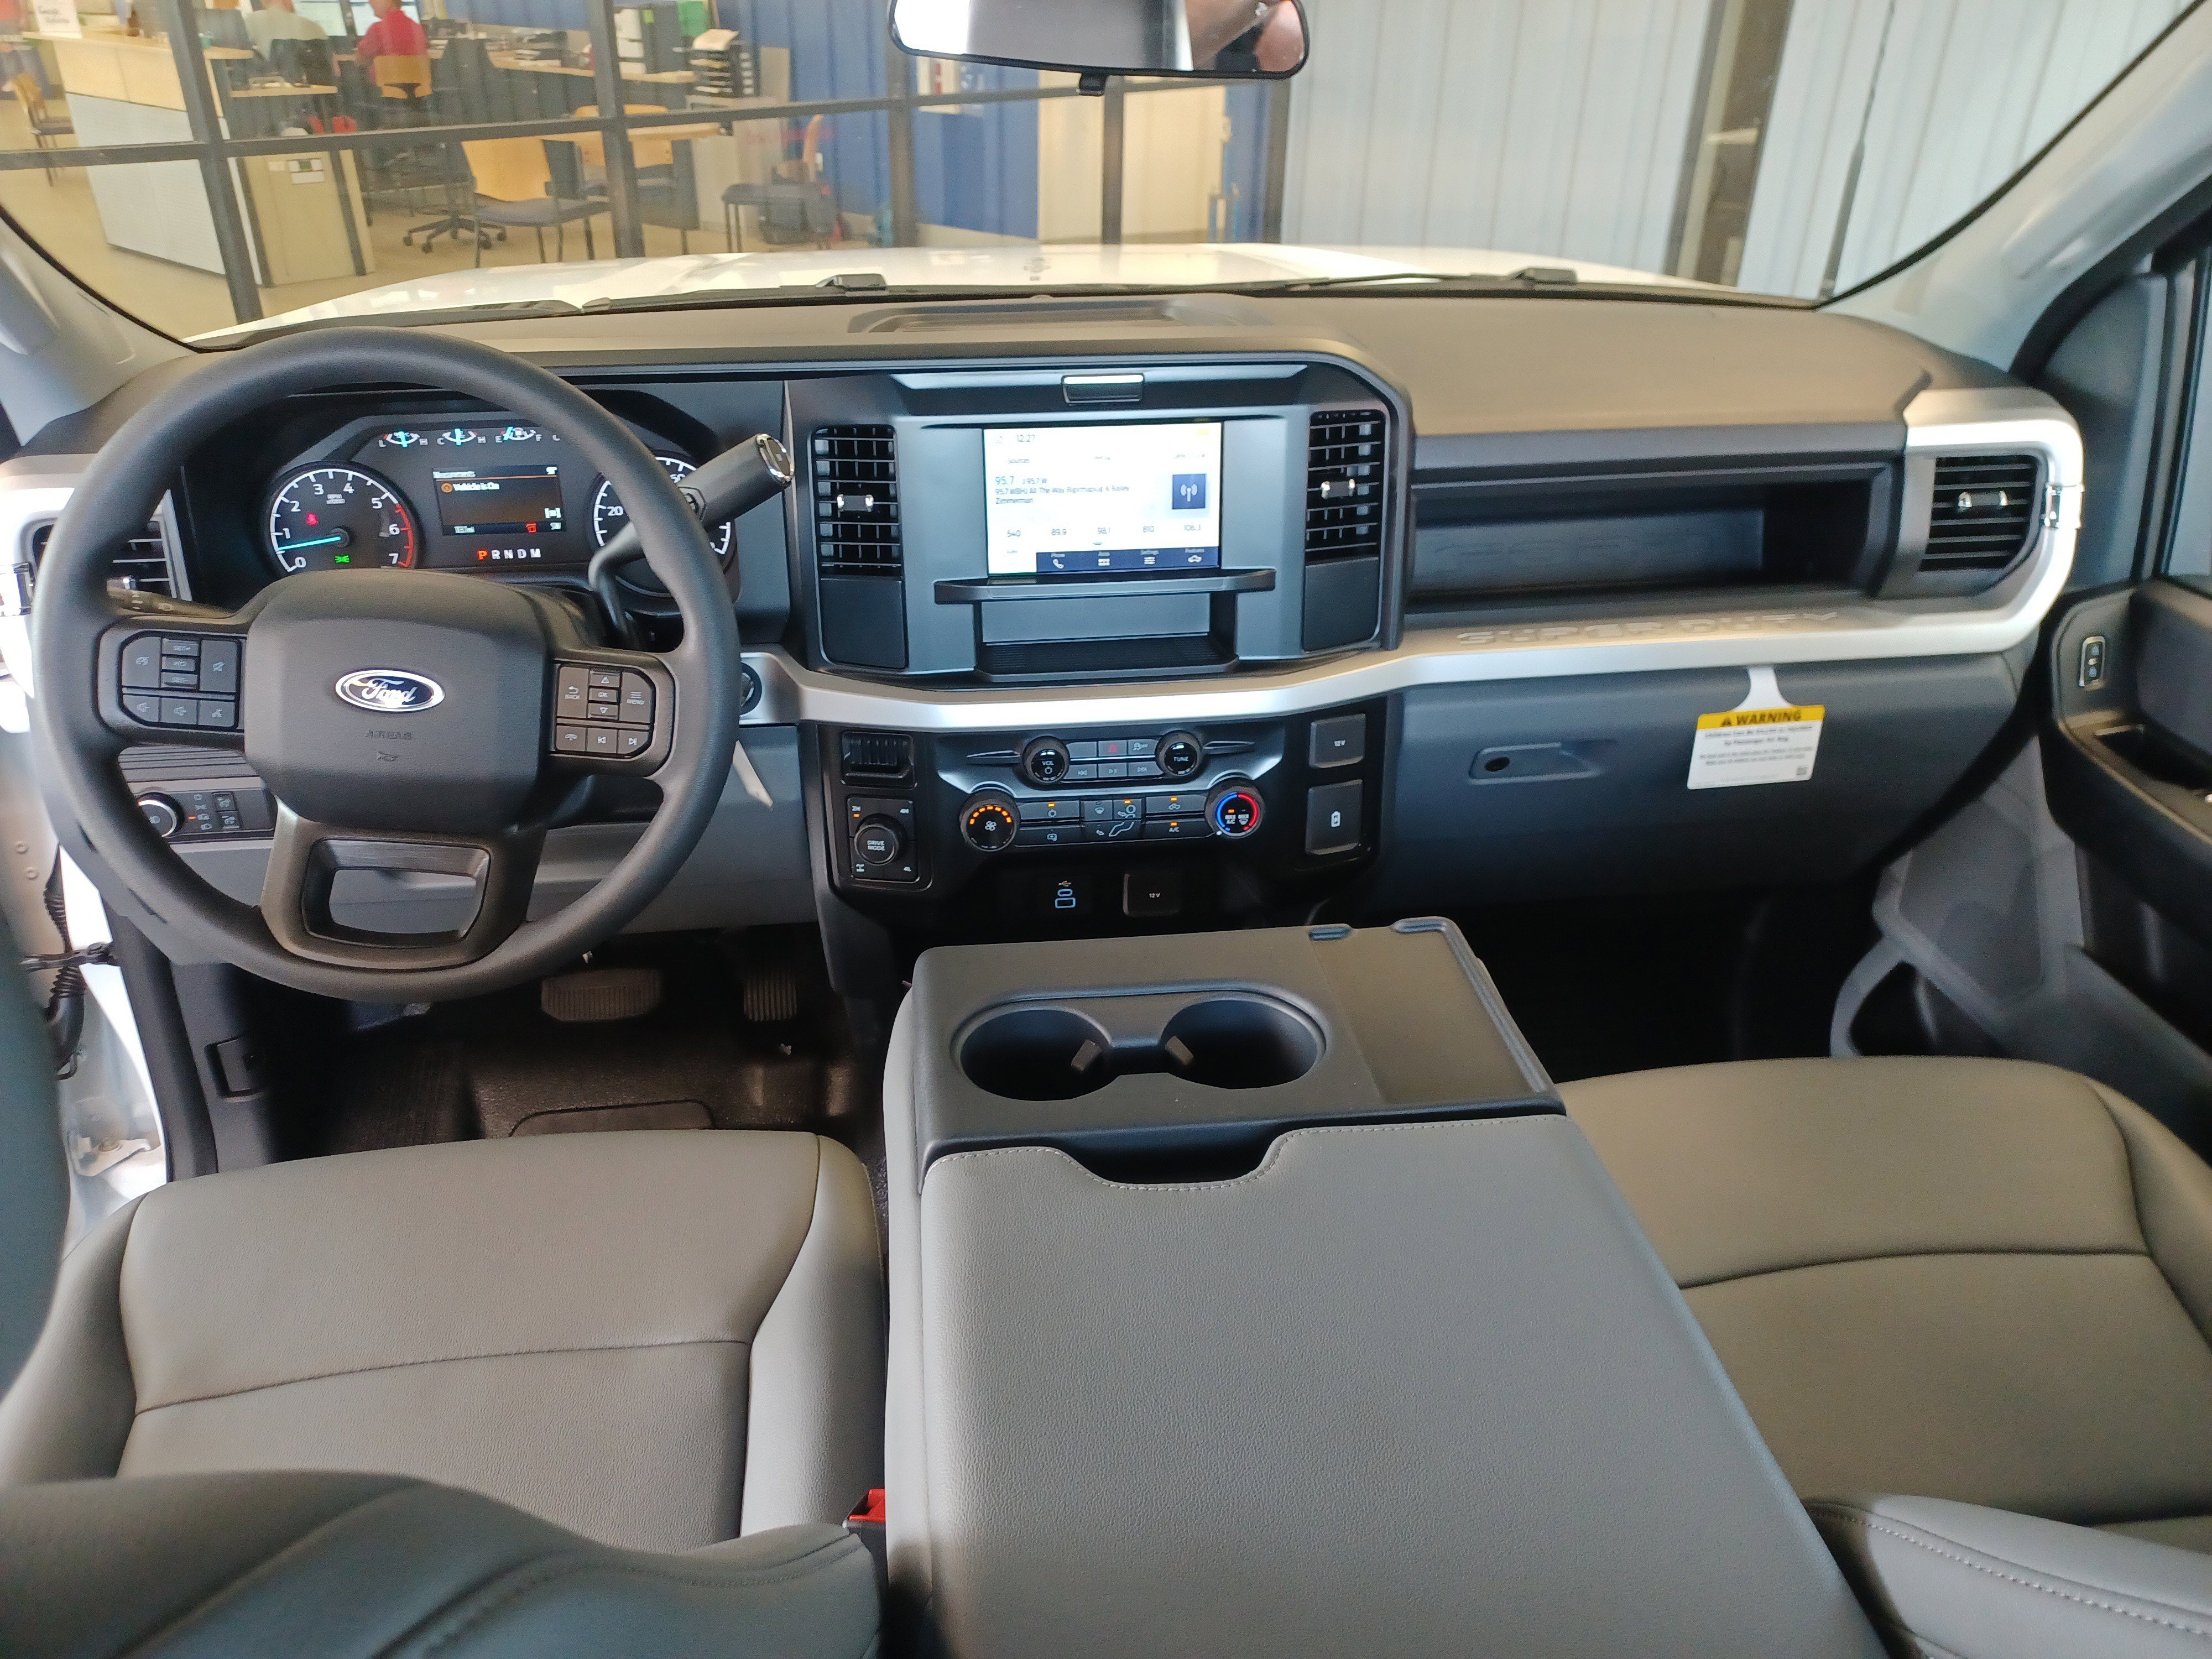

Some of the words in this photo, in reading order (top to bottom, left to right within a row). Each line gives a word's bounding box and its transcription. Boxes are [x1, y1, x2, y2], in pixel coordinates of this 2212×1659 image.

[312, 483, 324, 495] 3
[343, 482, 354, 494] 4
[290, 500, 301, 512] 2
[371, 498, 383, 509] 5
[607, 505, 624, 516] 20
[283, 528, 290, 539] 1
[389, 524, 400, 535] 6
[295, 556, 306, 568] 0
[388, 553, 399, 564] 7
[361, 678, 418, 706] Ford
[1736, 709, 1802, 726] WARNING
